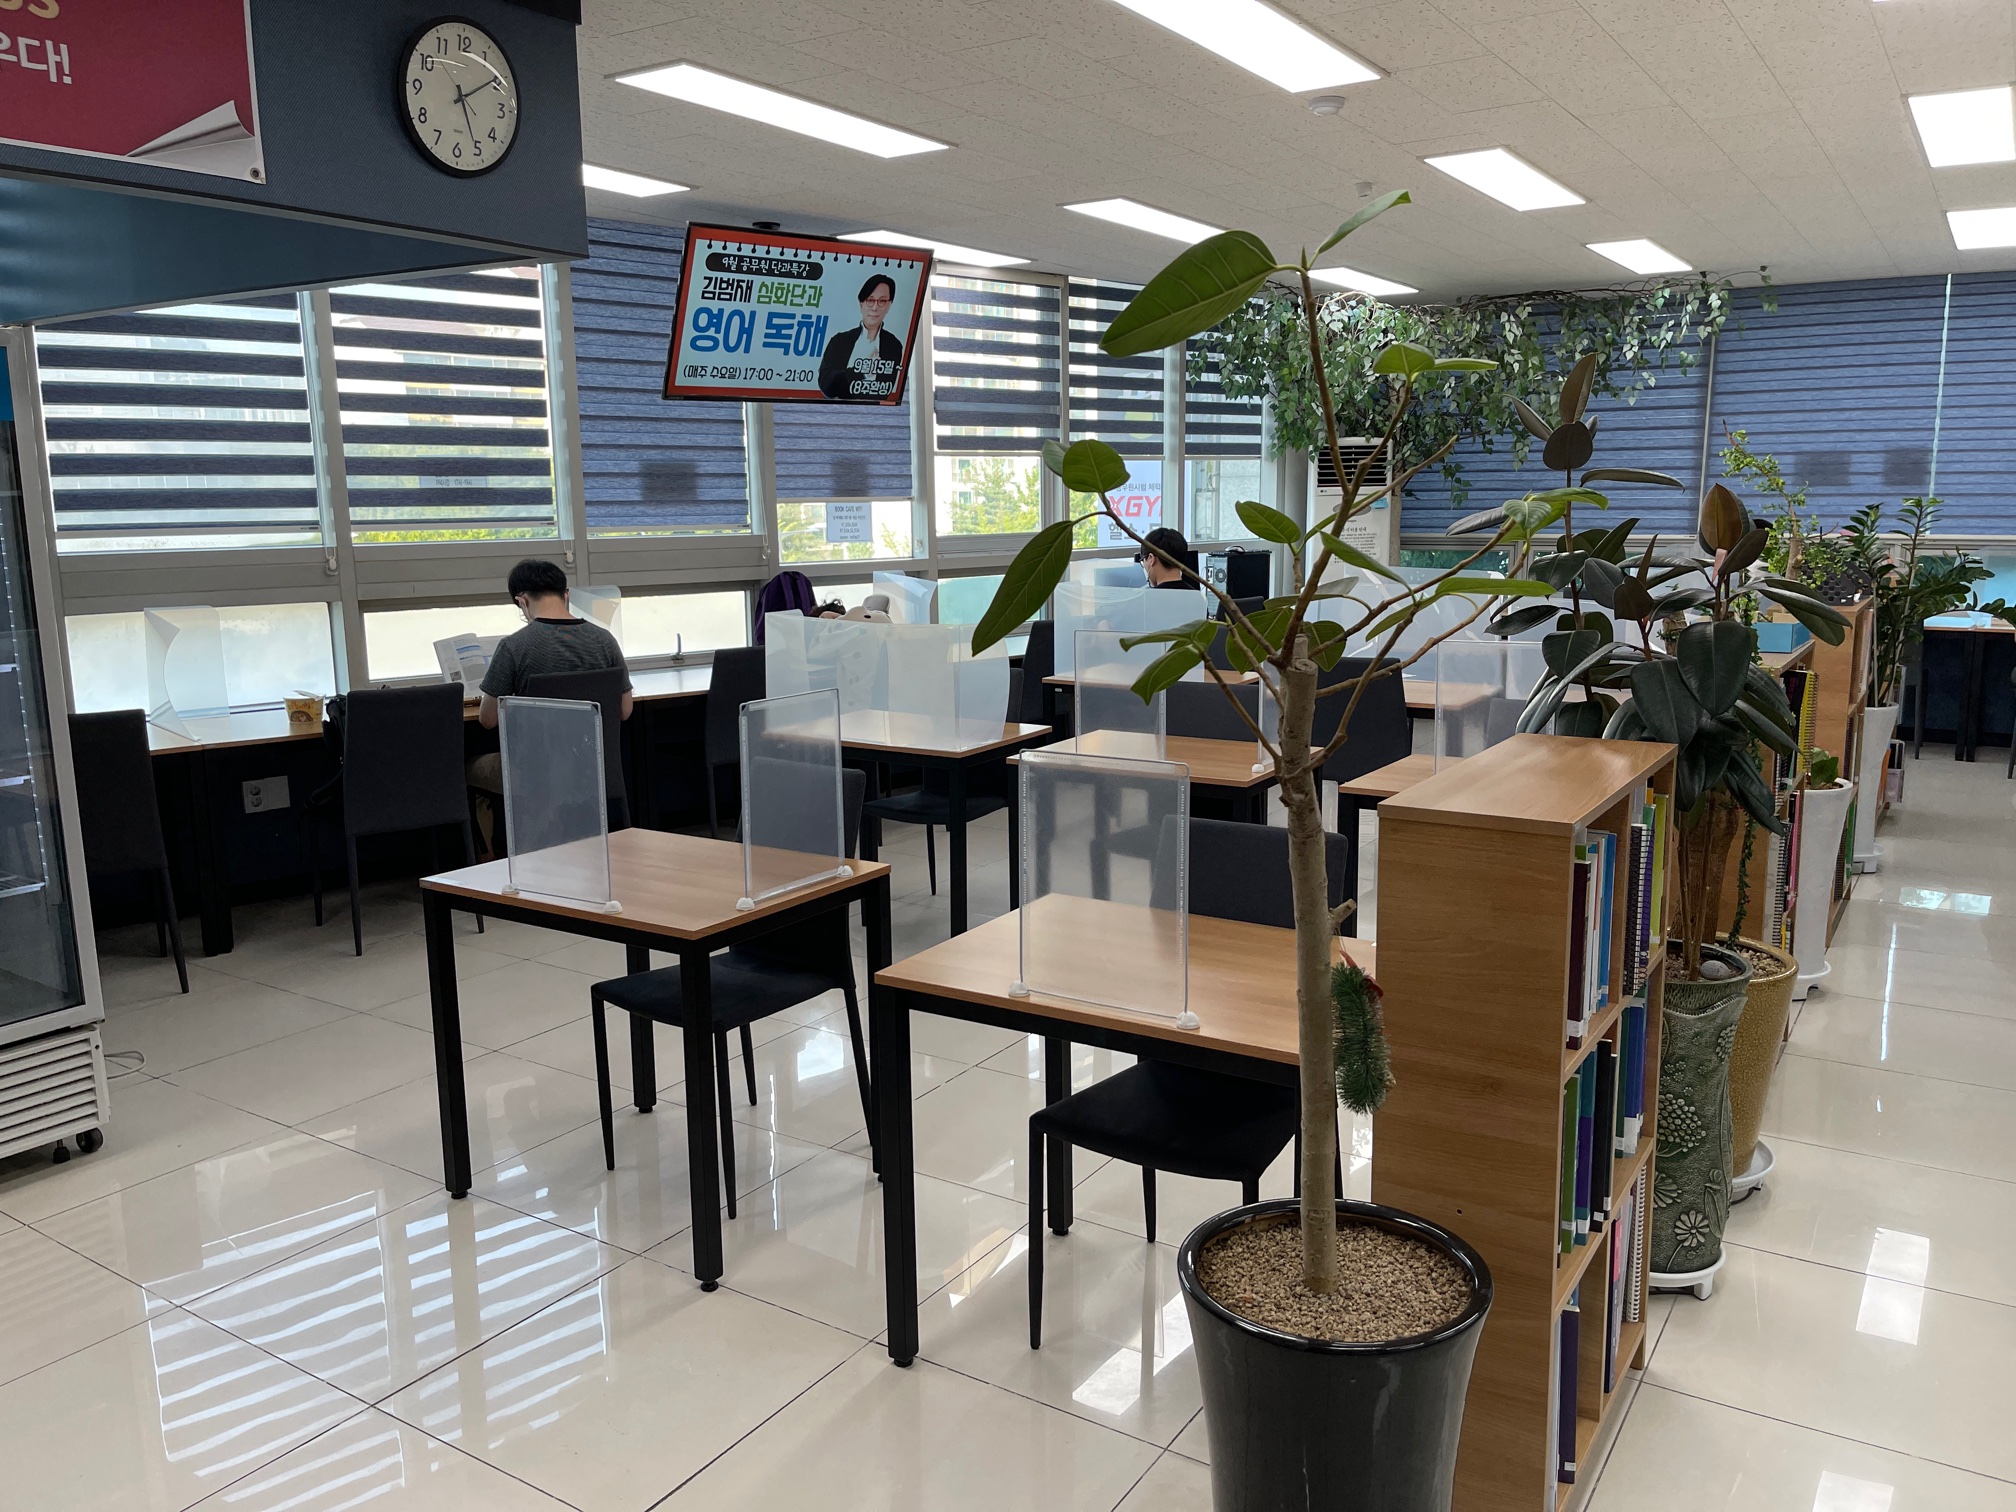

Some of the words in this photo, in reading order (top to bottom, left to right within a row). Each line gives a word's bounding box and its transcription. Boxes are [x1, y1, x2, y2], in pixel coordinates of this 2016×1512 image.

[436, 36, 448, 55] 11
[457, 33, 472, 53] 12
[419, 53, 435, 72] 10
[412, 78, 423, 95] 9
[417, 107, 428, 124] 8
[496, 103, 506, 119] 3
[433, 129, 443, 145] 7
[487, 127, 498, 143] 4
[452, 142, 462, 158] 6
[473, 140, 482, 157] 5
[722, 256, 738, 271] 9월
[740, 257, 769, 273] 공무원
[771, 260, 810, 277] 단과특강
[701, 276, 754, 303] 김범재
[756, 281, 823, 308] 심화단과
[689, 306, 757, 354] 영어
[762, 311, 829, 357] 독해
[683, 364, 708, 379] (매주
[710, 365, 741, 380] 수요일)
[743, 367, 774, 381] 17:00
[784, 369, 814, 382] 21:00
[853, 359, 871, 374] 9월
[872, 360, 895, 375] 15일
[849, 380, 893, 396] (8주완성)
[1108, 495, 1162, 517] XGY
